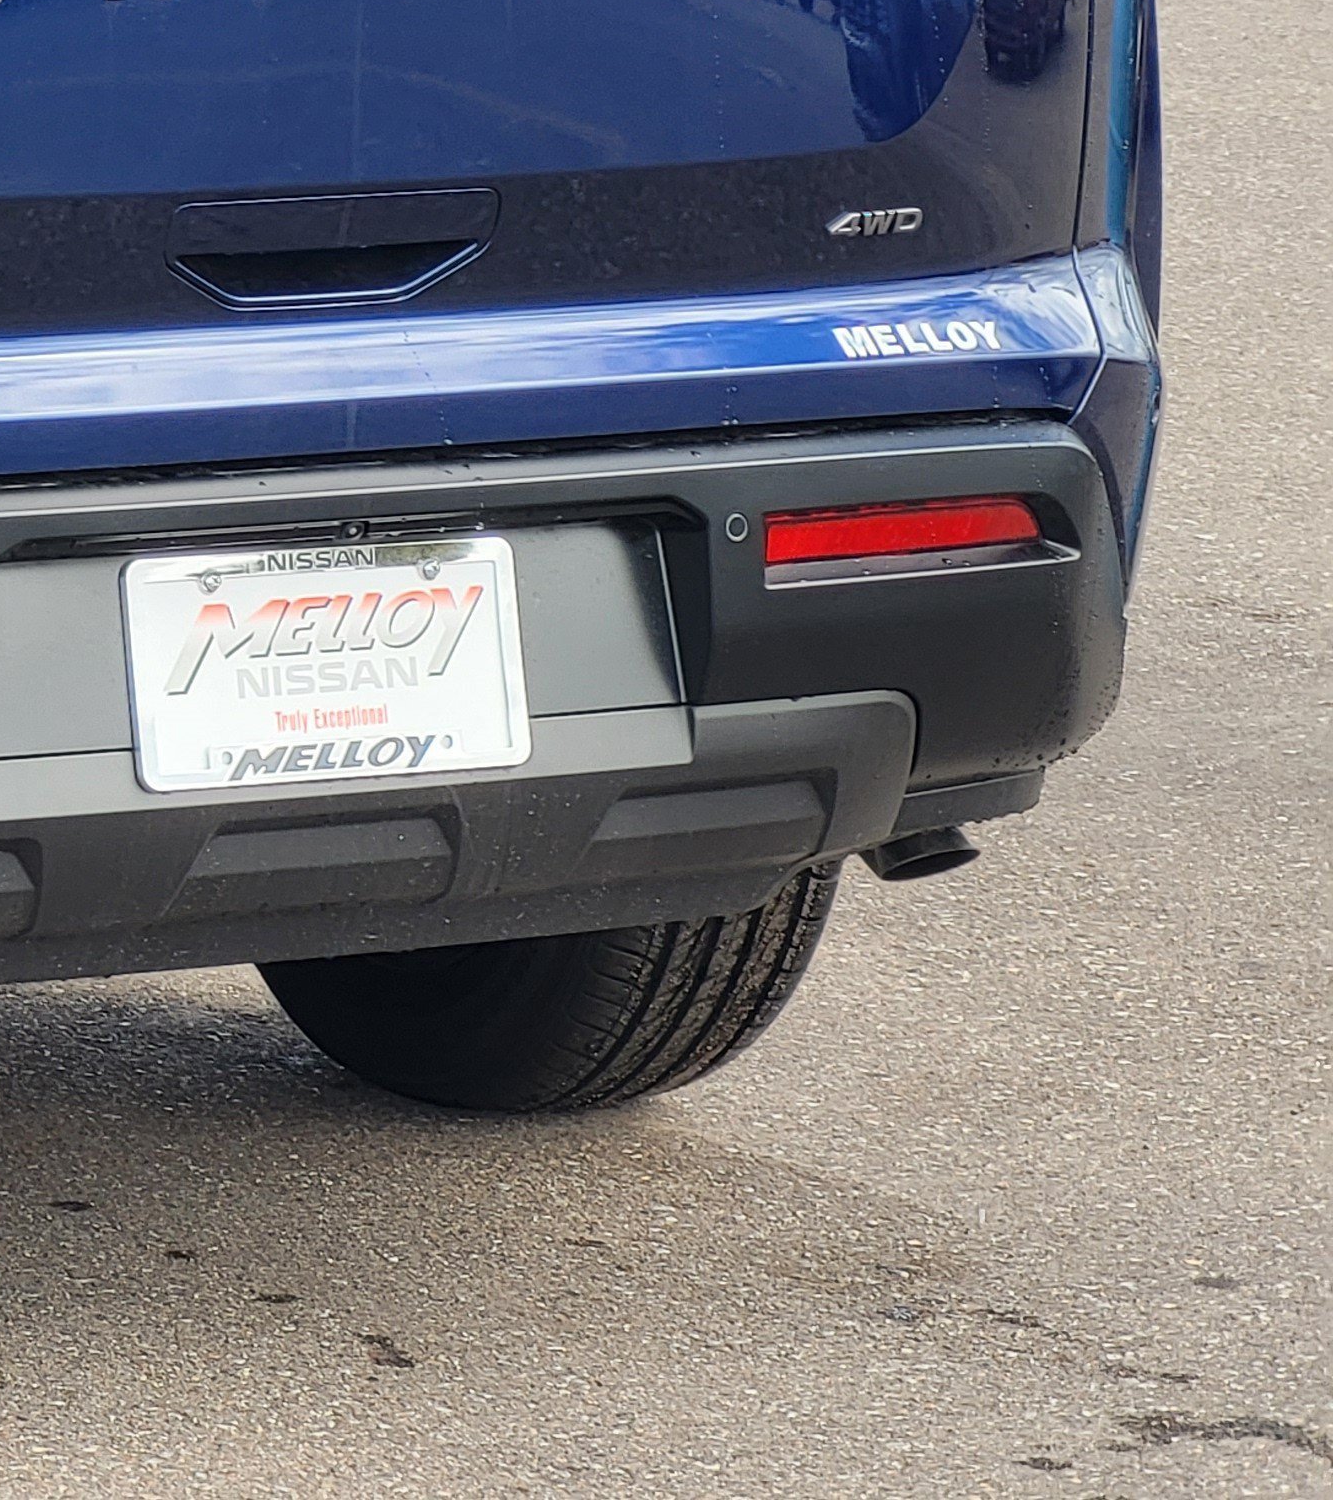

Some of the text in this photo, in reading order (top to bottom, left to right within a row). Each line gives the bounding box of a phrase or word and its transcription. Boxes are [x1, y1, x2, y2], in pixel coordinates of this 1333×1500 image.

[824, 207, 923, 237] 4WD
[832, 320, 1001, 359] MELLOY
[265, 547, 377, 572] NISSAN
[164, 585, 484, 696] MELLOY
[235, 656, 418, 698] NISSAN
[274, 703, 389, 734] Truly Exceptional
[227, 734, 437, 782] MELLOY
